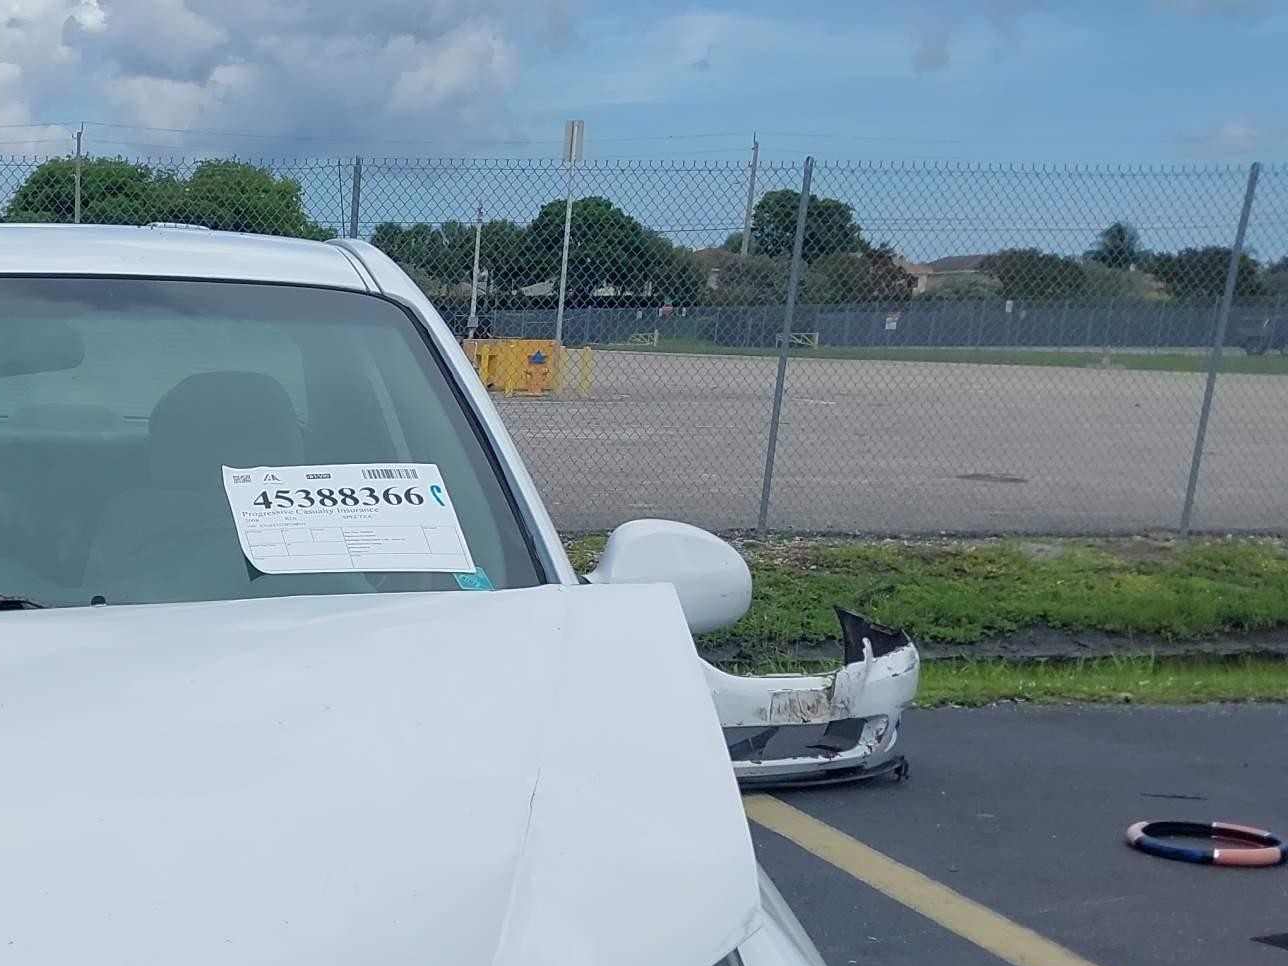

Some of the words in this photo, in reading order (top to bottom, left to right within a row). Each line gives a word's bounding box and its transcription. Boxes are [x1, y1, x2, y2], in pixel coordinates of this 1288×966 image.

[253, 486, 424, 509] 45388366
[242, 509, 293, 518] Progressive
[296, 507, 334, 516] Casualty
